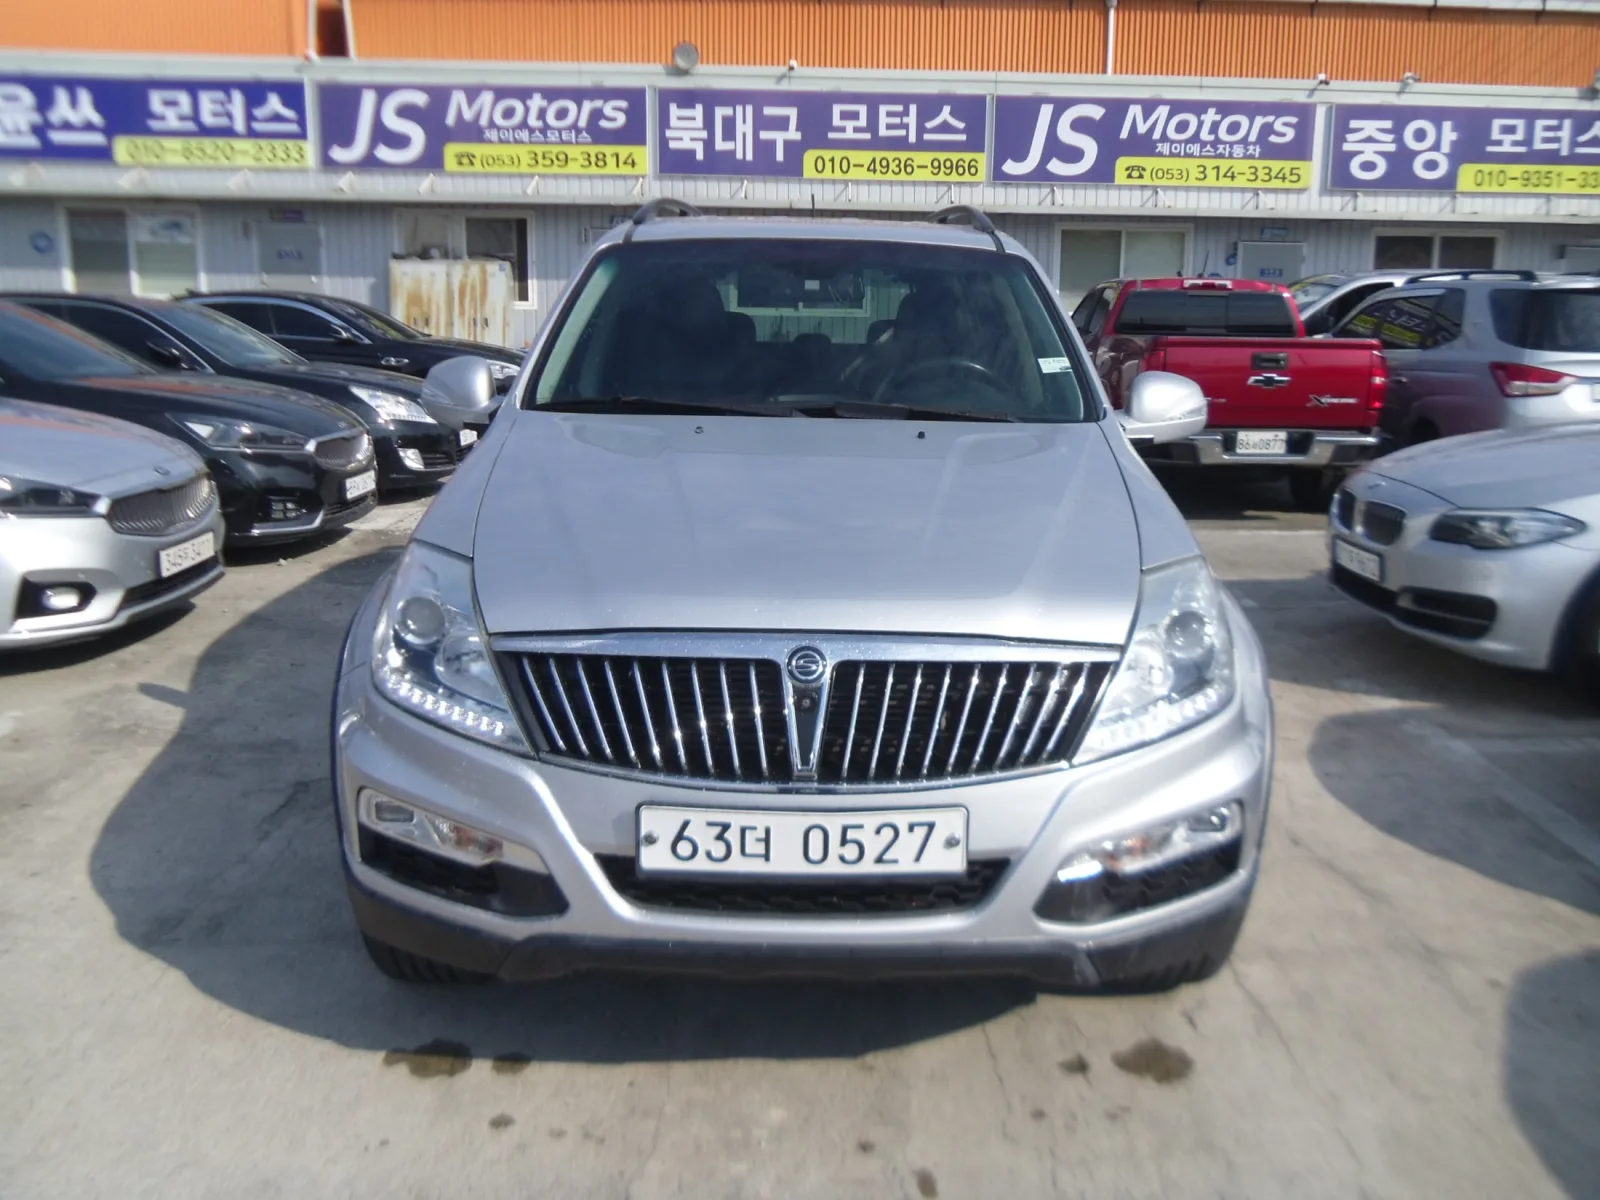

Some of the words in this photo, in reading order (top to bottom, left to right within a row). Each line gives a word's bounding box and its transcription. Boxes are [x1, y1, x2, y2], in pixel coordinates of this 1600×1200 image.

[146, 87, 301, 135] 모터스
[328, 88, 430, 165] JS
[445, 89, 629, 129] Motors
[665, 102, 802, 162] 북대구
[827, 103, 967, 144] 모터스
[480, 153, 521, 169] (053)
[526, 149, 638, 170] 359-3814
[482, 127, 593, 145] 제이에스모터스
[1001, 103, 1106, 176] JS
[1119, 104, 1299, 143] Motors
[1155, 142, 1262, 158] 제이에스자동차
[1342, 119, 1457, 180] 중앙
[814, 155, 979, 178] 010-4936-9966
[1149, 166, 1190, 183] (053)
[1194, 164, 1302, 184] 314-3345
[670, 818, 771, 863] 63더
[802, 821, 937, 865] 0527
